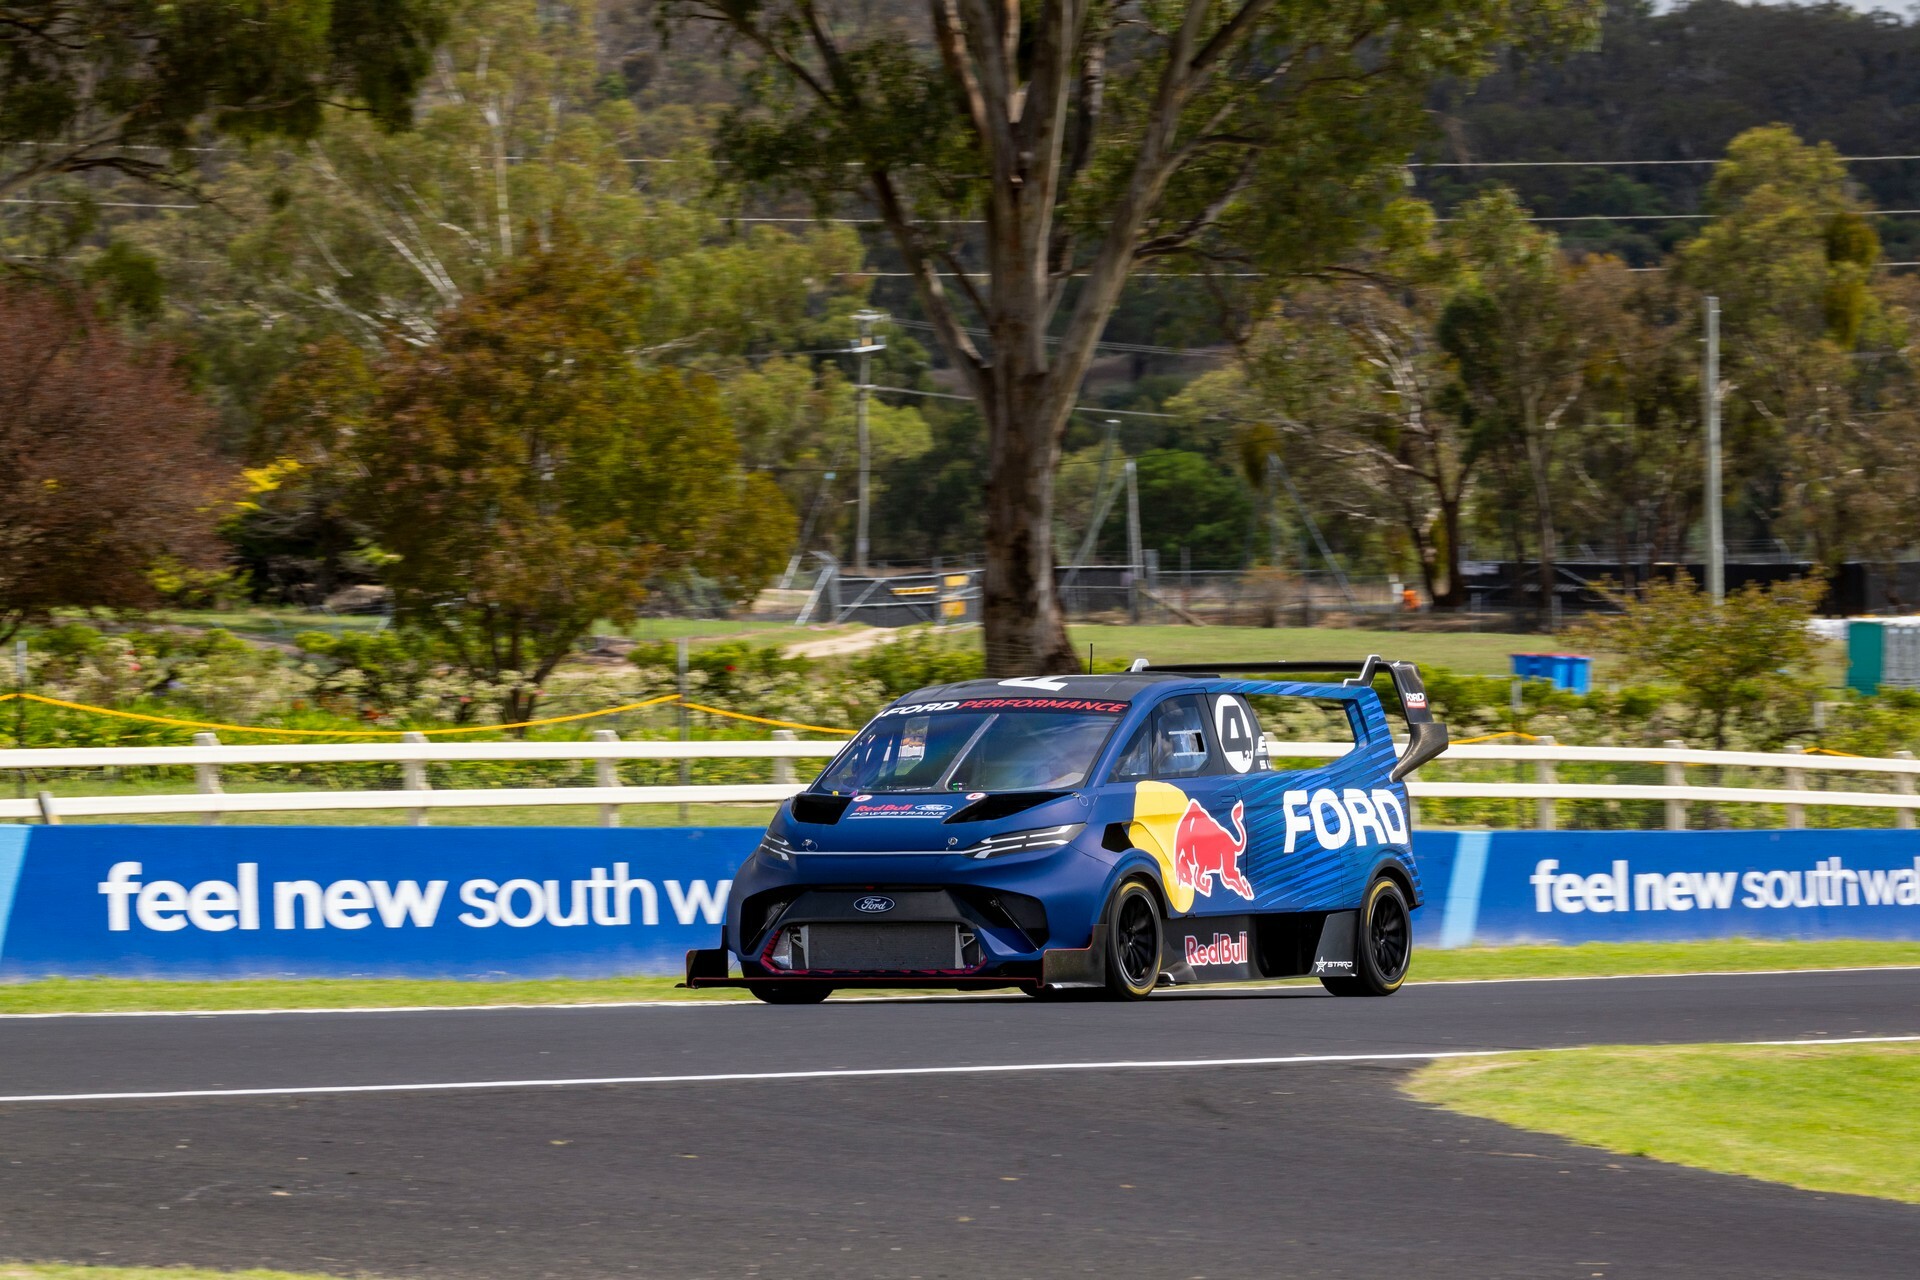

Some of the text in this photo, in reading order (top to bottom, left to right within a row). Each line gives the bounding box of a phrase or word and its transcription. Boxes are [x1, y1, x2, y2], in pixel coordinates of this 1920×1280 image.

[881, 699, 1129, 717] FORD PERFORMANCE
[1283, 788, 1409, 853] FORD
[98, 862, 259, 931] feel
[274, 880, 448, 929] new
[459, 862, 658, 927] south
[1530, 859, 1629, 913] feel
[1634, 872, 1738, 911] new
[1742, 857, 1859, 908] south
[861, 897, 887, 909] Ford
[1185, 931, 1248, 966] Red Bull
[1327, 961, 1353, 969] STARD
